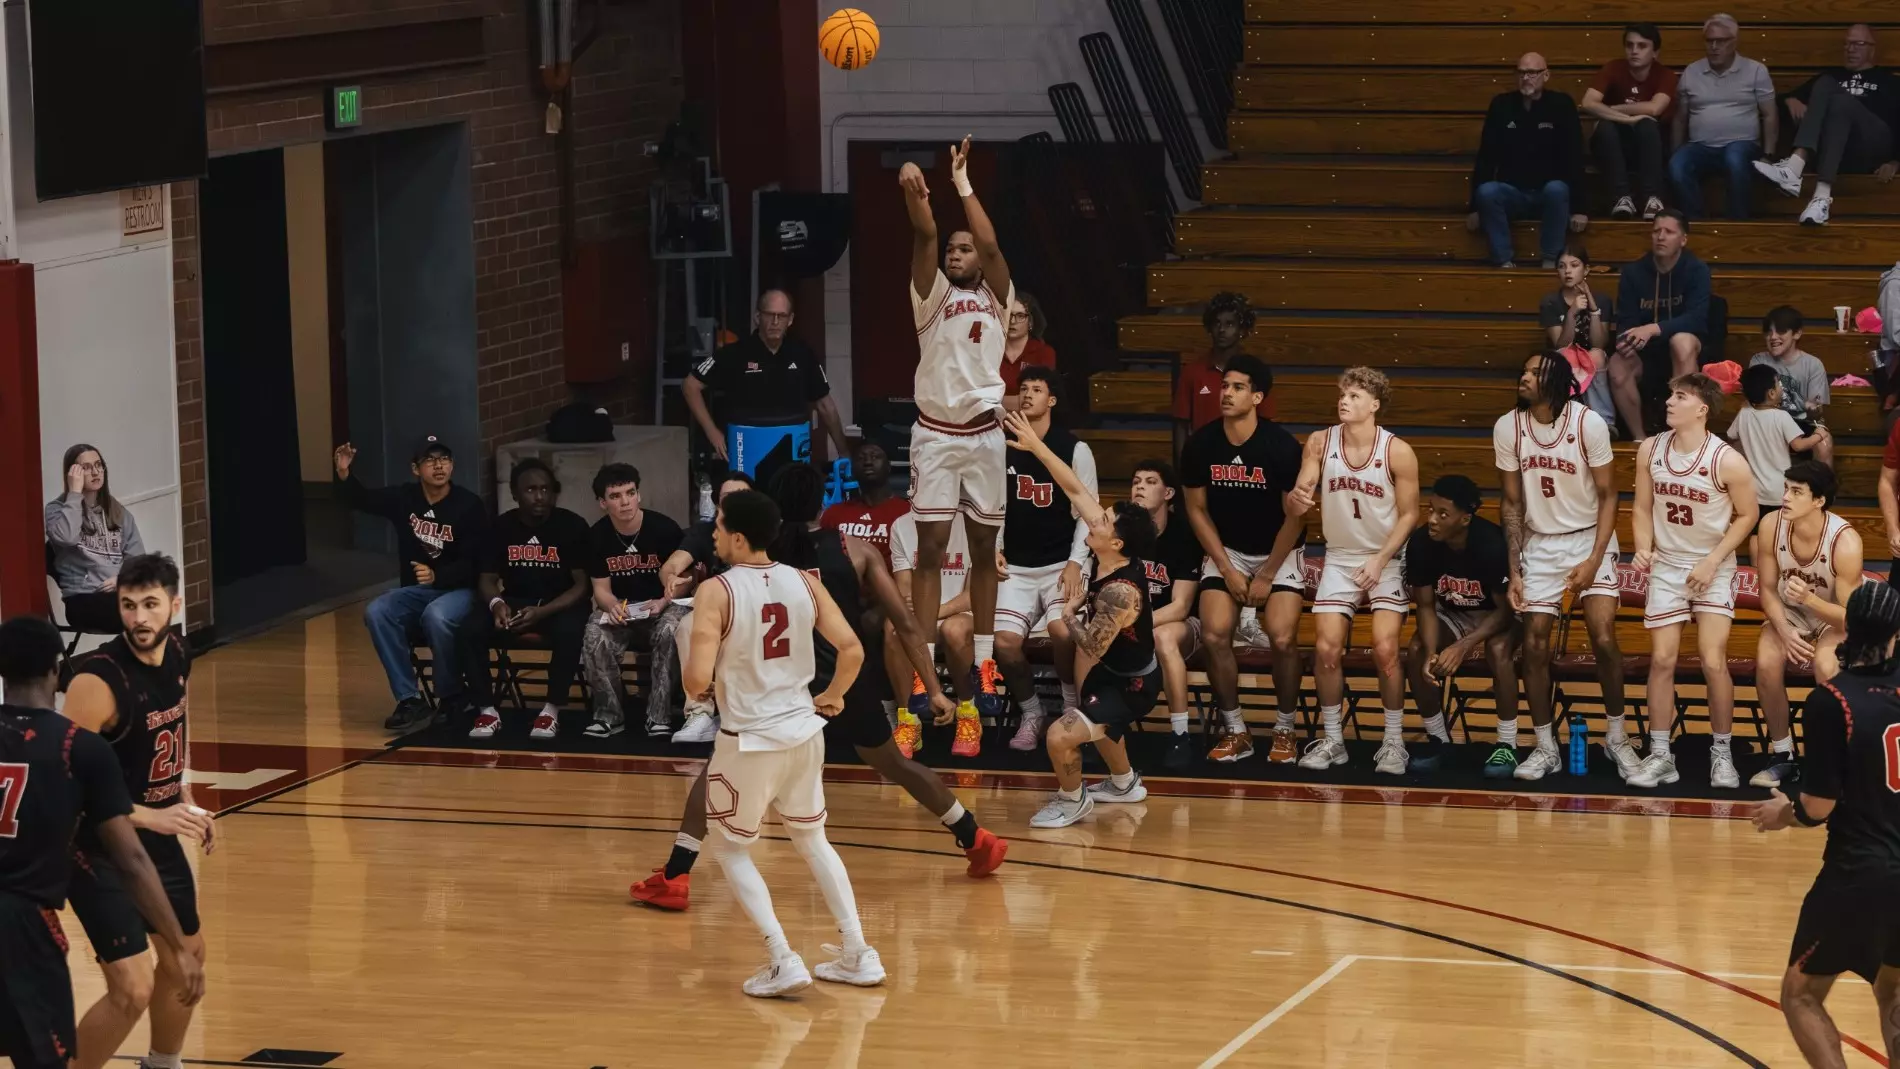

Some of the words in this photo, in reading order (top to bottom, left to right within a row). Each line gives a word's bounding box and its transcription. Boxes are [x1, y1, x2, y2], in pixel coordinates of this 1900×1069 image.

[339, 90, 357, 123] EXIT
[125, 202, 162, 229] RESTROOM
[968, 321, 982, 344] 4
[1210, 464, 1267, 484] BIOLA
[1521, 455, 1577, 475] EAGLES
[1016, 474, 1054, 508] BU
[1329, 476, 1385, 499] EAGLES
[1540, 475, 1556, 498] 5
[1352, 498, 1362, 520] 1
[1665, 501, 1694, 526] 23
[507, 544, 560, 562] BIOLA
[606, 554, 661, 572] BIOLA
[761, 602, 790, 660] 2
[148, 721, 184, 783] 21
